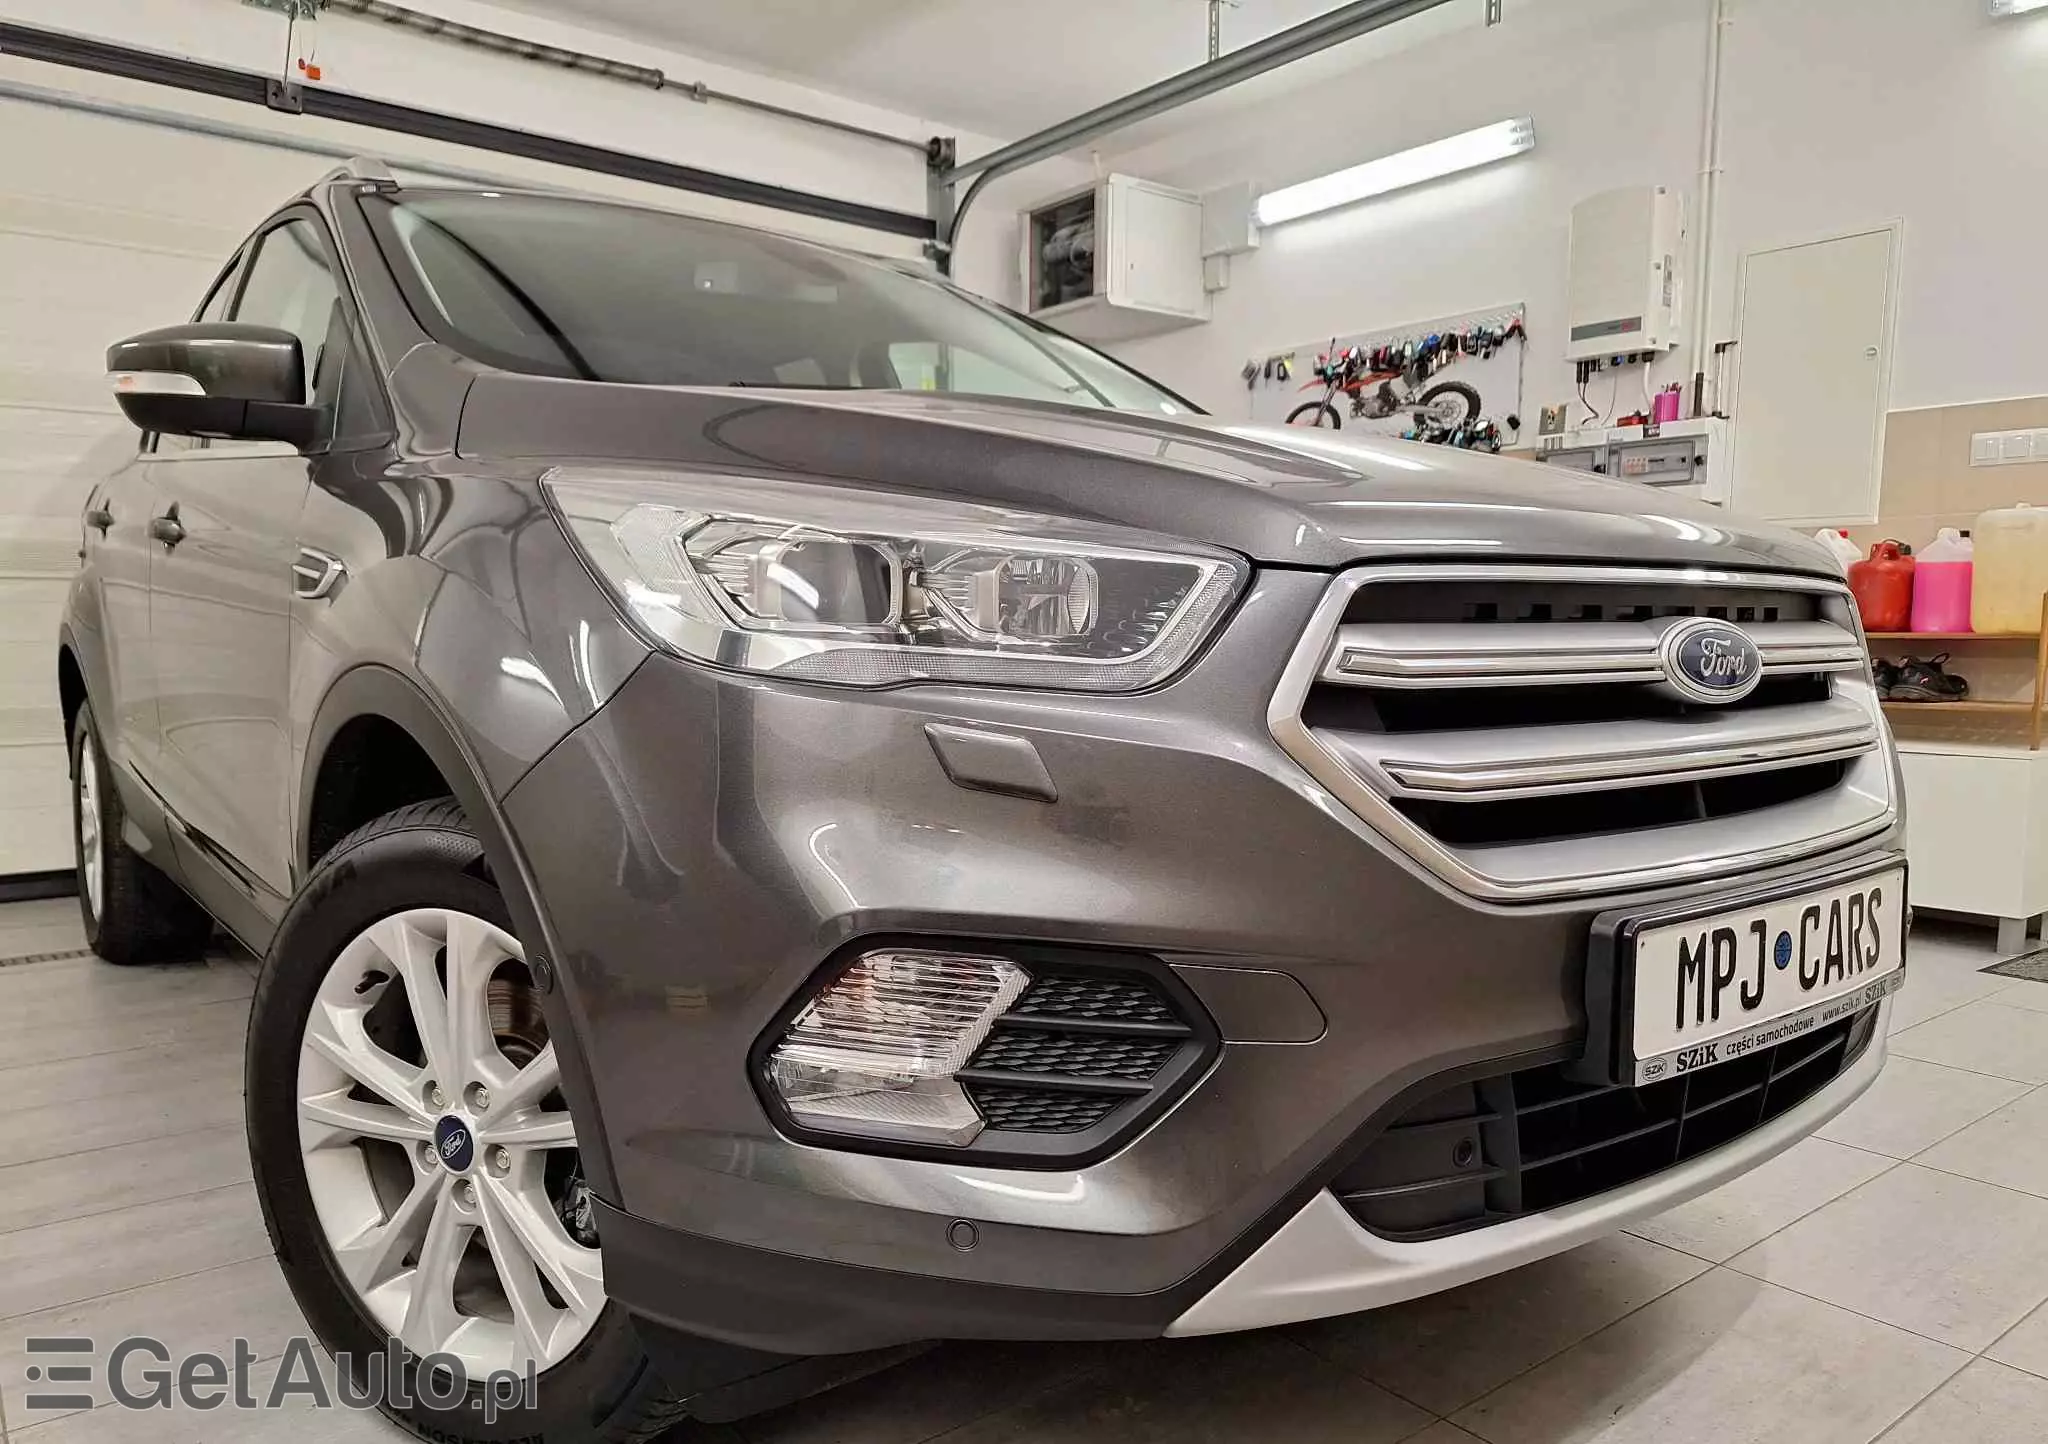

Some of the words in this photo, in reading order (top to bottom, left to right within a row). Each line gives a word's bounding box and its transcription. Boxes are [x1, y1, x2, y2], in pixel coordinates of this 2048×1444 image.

[1701, 638, 1747, 677] Ford
[1676, 919, 1767, 1030] MPJ
[1800, 887, 1882, 991] CARS
[1677, 1043, 1718, 1073] SZiK
[1726, 1034, 1754, 1056] części
[1756, 1016, 1814, 1046] samochodowe
[1822, 992, 1861, 1021] www.szik.pl
[1864, 979, 1887, 1004] SZiK
[443, 1134, 462, 1156] Ford
